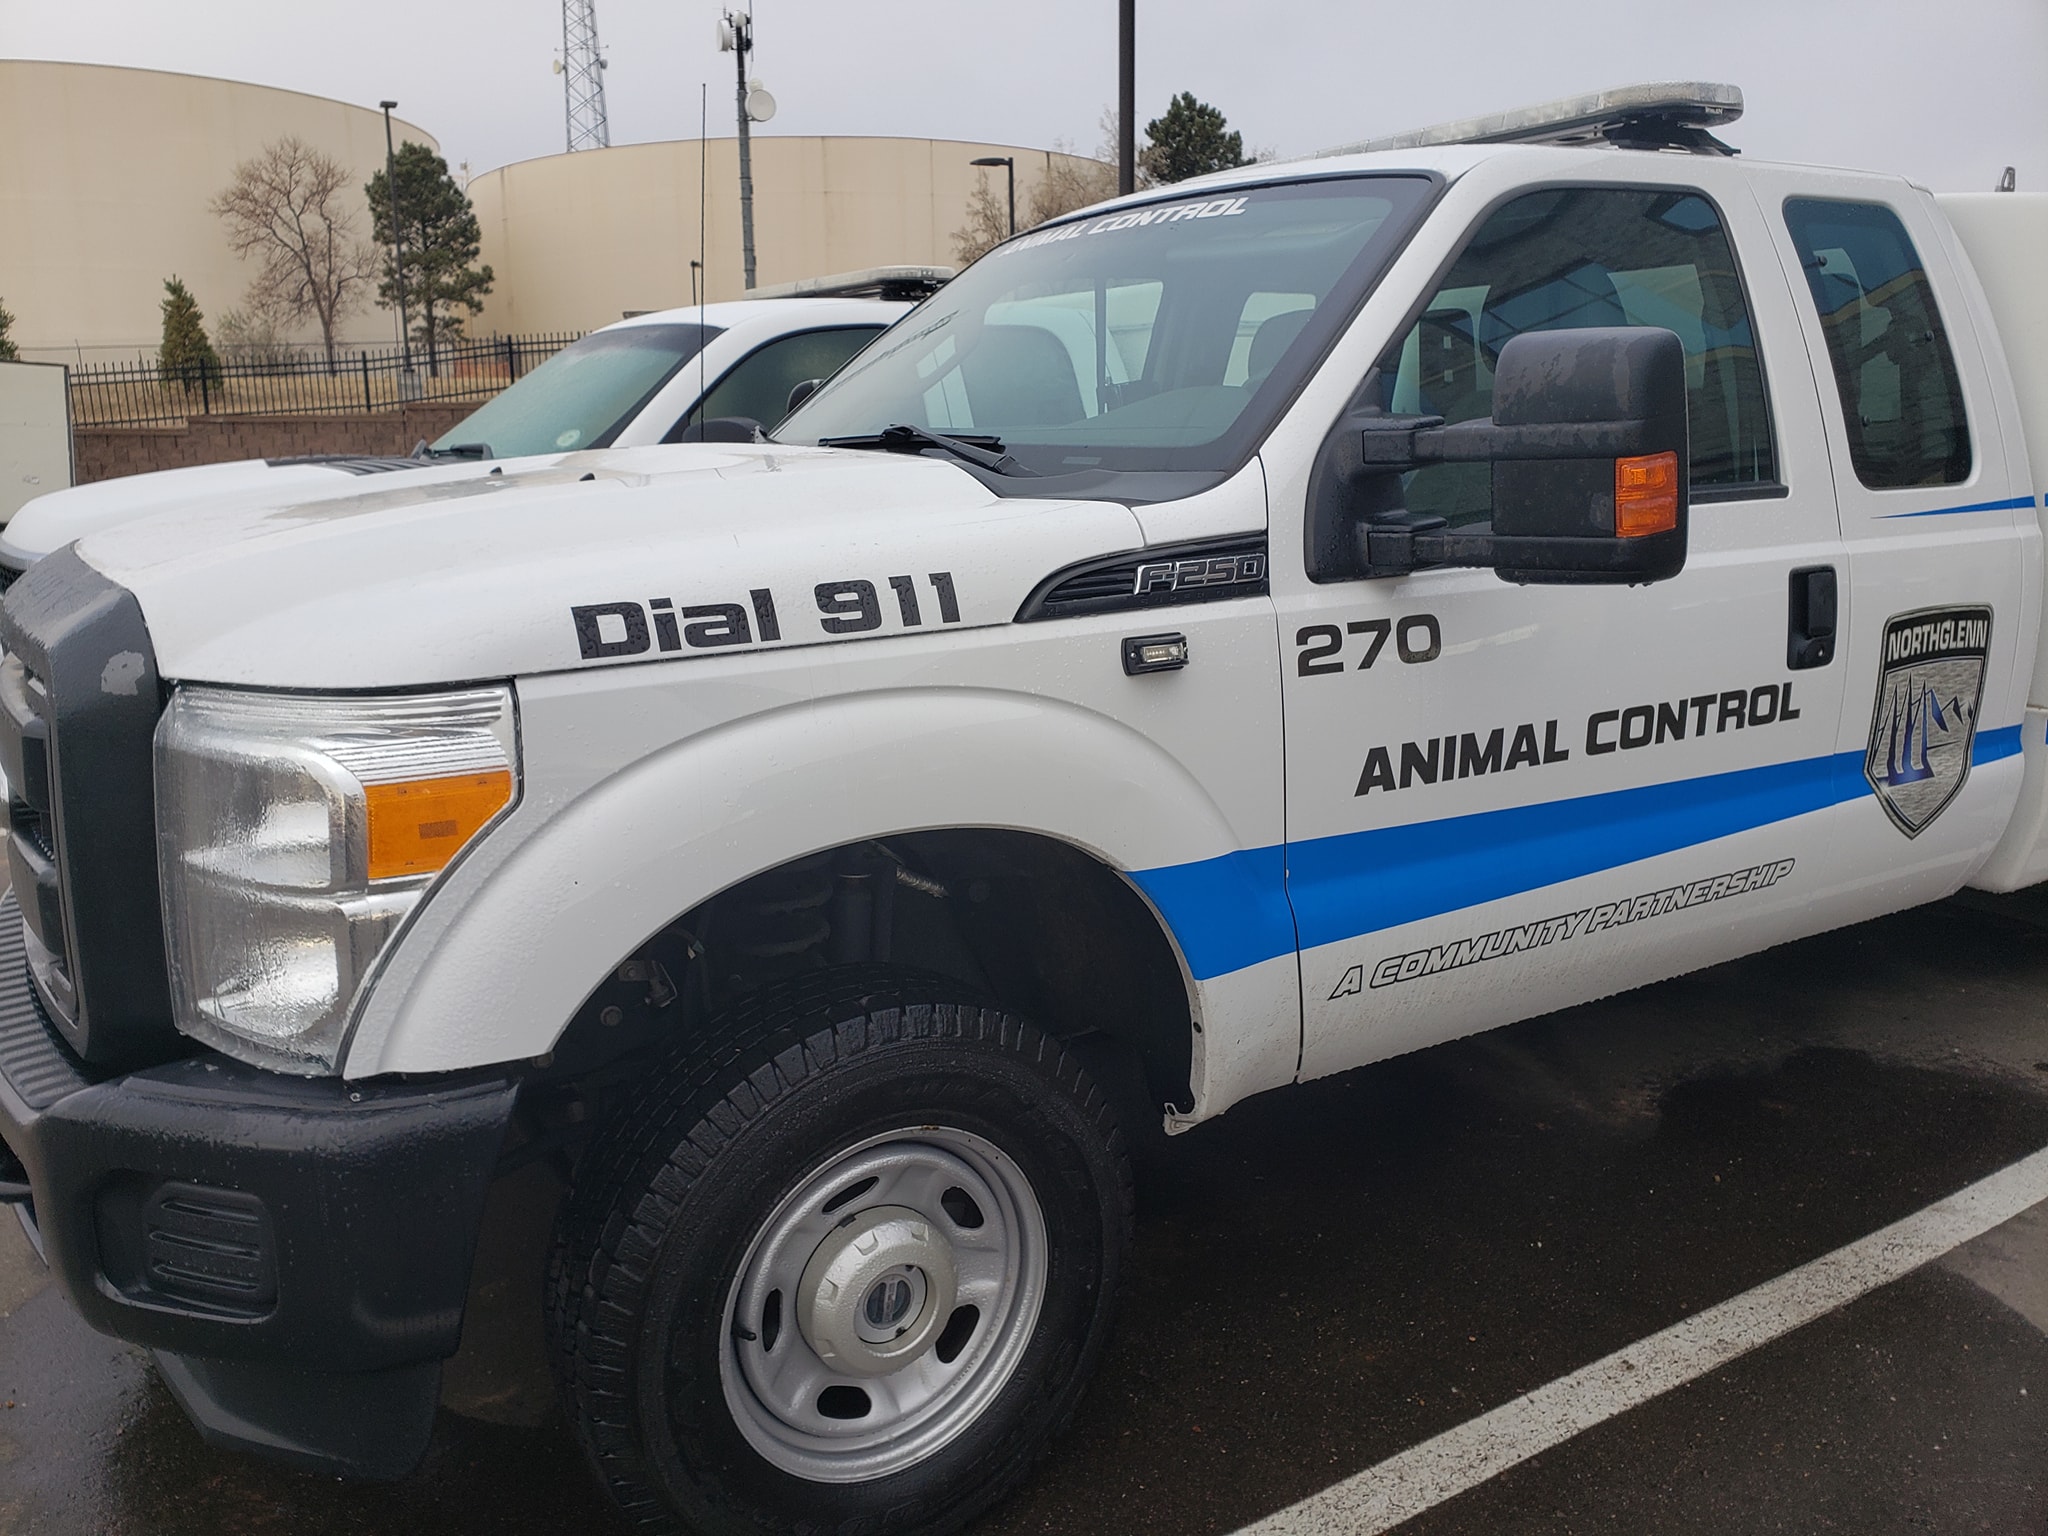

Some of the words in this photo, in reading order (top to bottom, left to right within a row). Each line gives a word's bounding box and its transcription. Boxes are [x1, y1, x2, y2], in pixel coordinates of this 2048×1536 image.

[998, 223, 1089, 257] ANIMAL
[1088, 198, 1249, 235] CONTROL
[1133, 553, 1266, 595] F-250
[571, 588, 781, 659] Dial
[813, 572, 961, 634] 911
[1296, 614, 1441, 677] 270
[1887, 620, 1987, 662] NORTHGLENN
[1354, 720, 1569, 797] ANIMAL
[1585, 682, 1800, 756] CONTROL
[1328, 965, 1363, 1001] A
[1369, 910, 1598, 989] COMMUNITY
[1586, 857, 1796, 934] PARTNERSHIP
